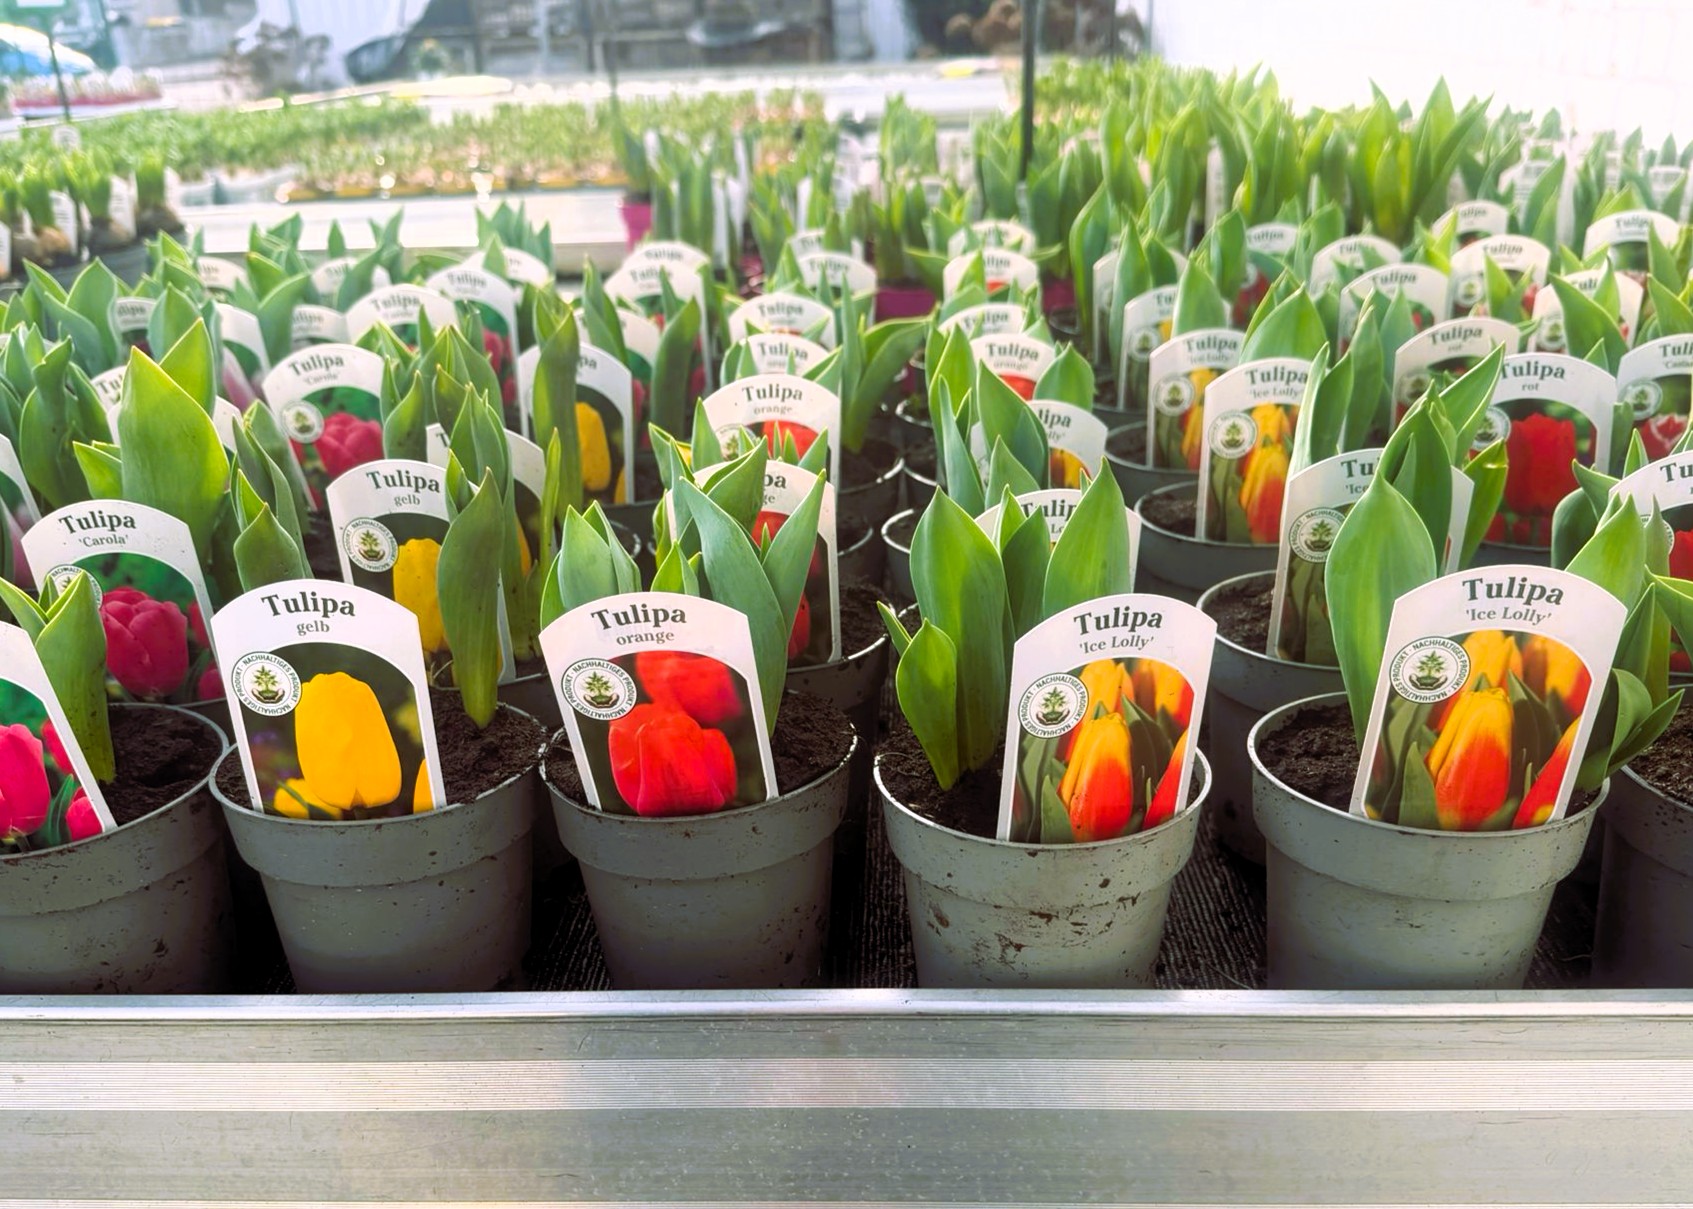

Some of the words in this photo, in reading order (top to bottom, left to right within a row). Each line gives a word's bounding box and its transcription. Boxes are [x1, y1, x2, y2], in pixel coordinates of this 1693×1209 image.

[1184, 335, 1239, 352] Tulipa
[1431, 325, 1483, 345] Tulipa
[985, 340, 1039, 361] Tulipa
[1658, 342, 1693, 357] Tuli
[288, 354, 345, 376] Tulipa
[1501, 360, 1566, 379] Tulipa
[1245, 366, 1308, 385] Tulipa
[742, 383, 804, 402] Tulipa
[1521, 382, 1539, 391] rot
[753, 405, 793, 416] orange
[1037, 408, 1072, 428] lipa
[366, 469, 440, 494] Tulipa
[394, 494, 421, 507] gelb
[59, 510, 137, 534] Tulipa
[79, 534, 129, 547] 'Carola'
[1462, 576, 1565, 605] Tulipa
[261, 591, 355, 618] Tulipa
[590, 603, 687, 630] Tulipa
[1074, 606, 1163, 635] Tulipa
[1466, 608, 1497, 621] 'Ice
[1502, 607, 1552, 626] Lolly'
[296, 620, 330, 636] gelb
[616, 631, 675, 646] orange
[1079, 641, 1106, 654] 'Ice
[1111, 635, 1154, 651] Lolly'
